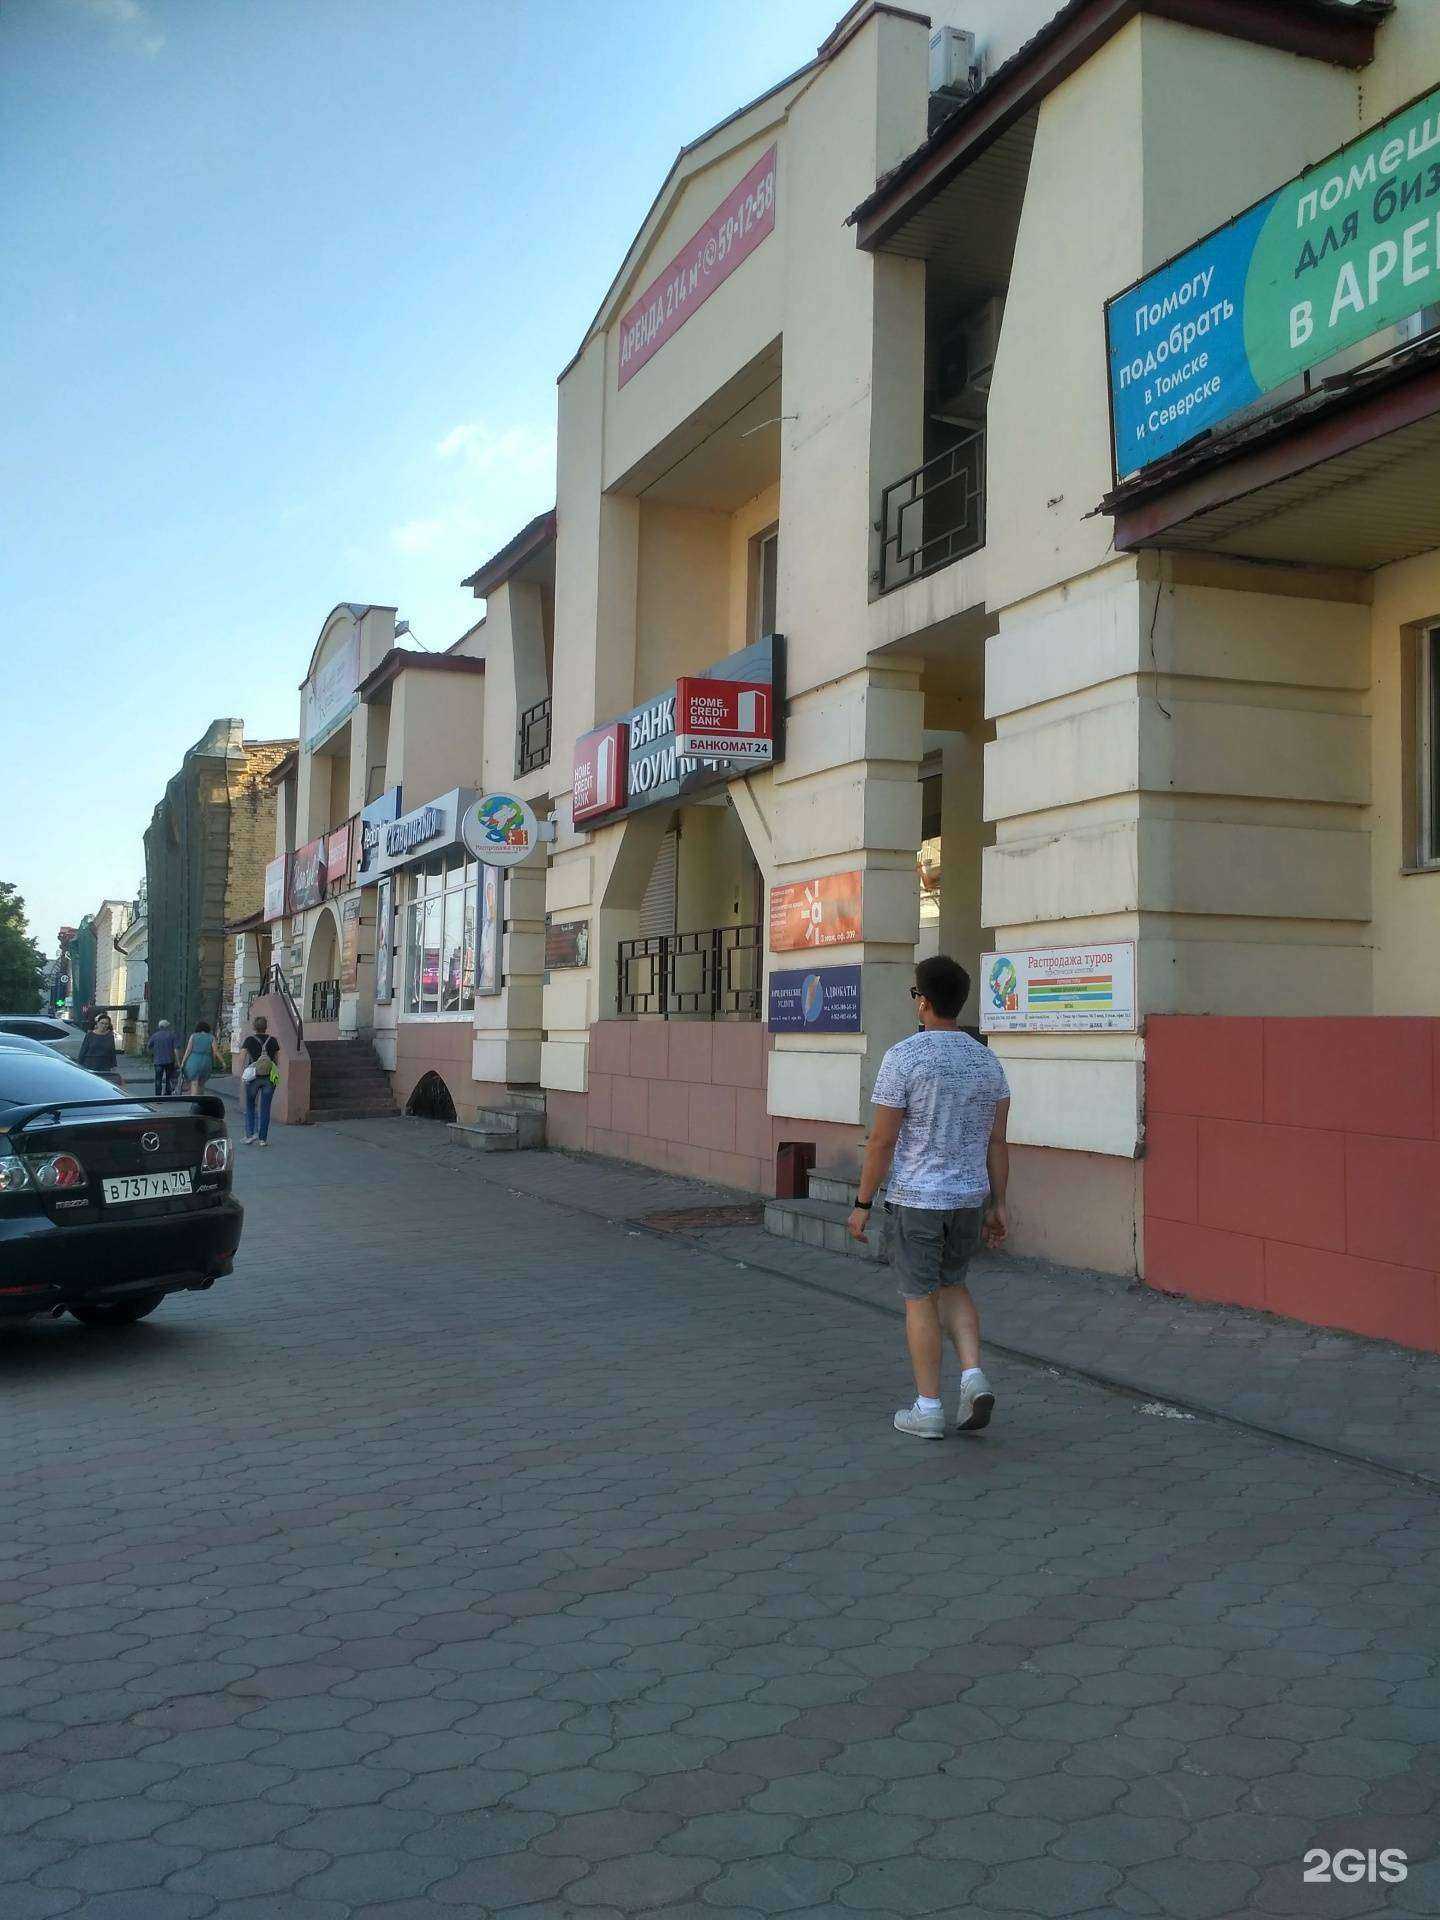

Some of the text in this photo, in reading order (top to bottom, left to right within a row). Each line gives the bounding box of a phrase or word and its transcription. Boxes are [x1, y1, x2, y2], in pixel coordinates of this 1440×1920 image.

[1294, 210, 1359, 279] для
[1328, 209, 1440, 327] АРЕ
[621, 295, 664, 367] АРЕНДА
[666, 268, 687, 319] 214
[718, 171, 774, 262] 59-12-58
[1134, 265, 1215, 336] Помогу
[1119, 298, 1234, 389] подобрать
[1144, 350, 1209, 405] в Томске
[1136, 373, 1222, 440] и Северске
[631, 696, 677, 750] БАНК
[690, 696, 724, 708] HOME
[690, 706, 729, 719] CREDIT
[690, 715, 721, 727] BANK
[574, 762, 591, 781] HOME
[574, 775, 593, 795] CREDIT
[630, 747, 678, 795] ХОУМ
[574, 792, 589, 808] BANK
[1028, 952, 1113, 970] Распродажа туров
[824, 985, 857, 999] АДВОКАТЫ
